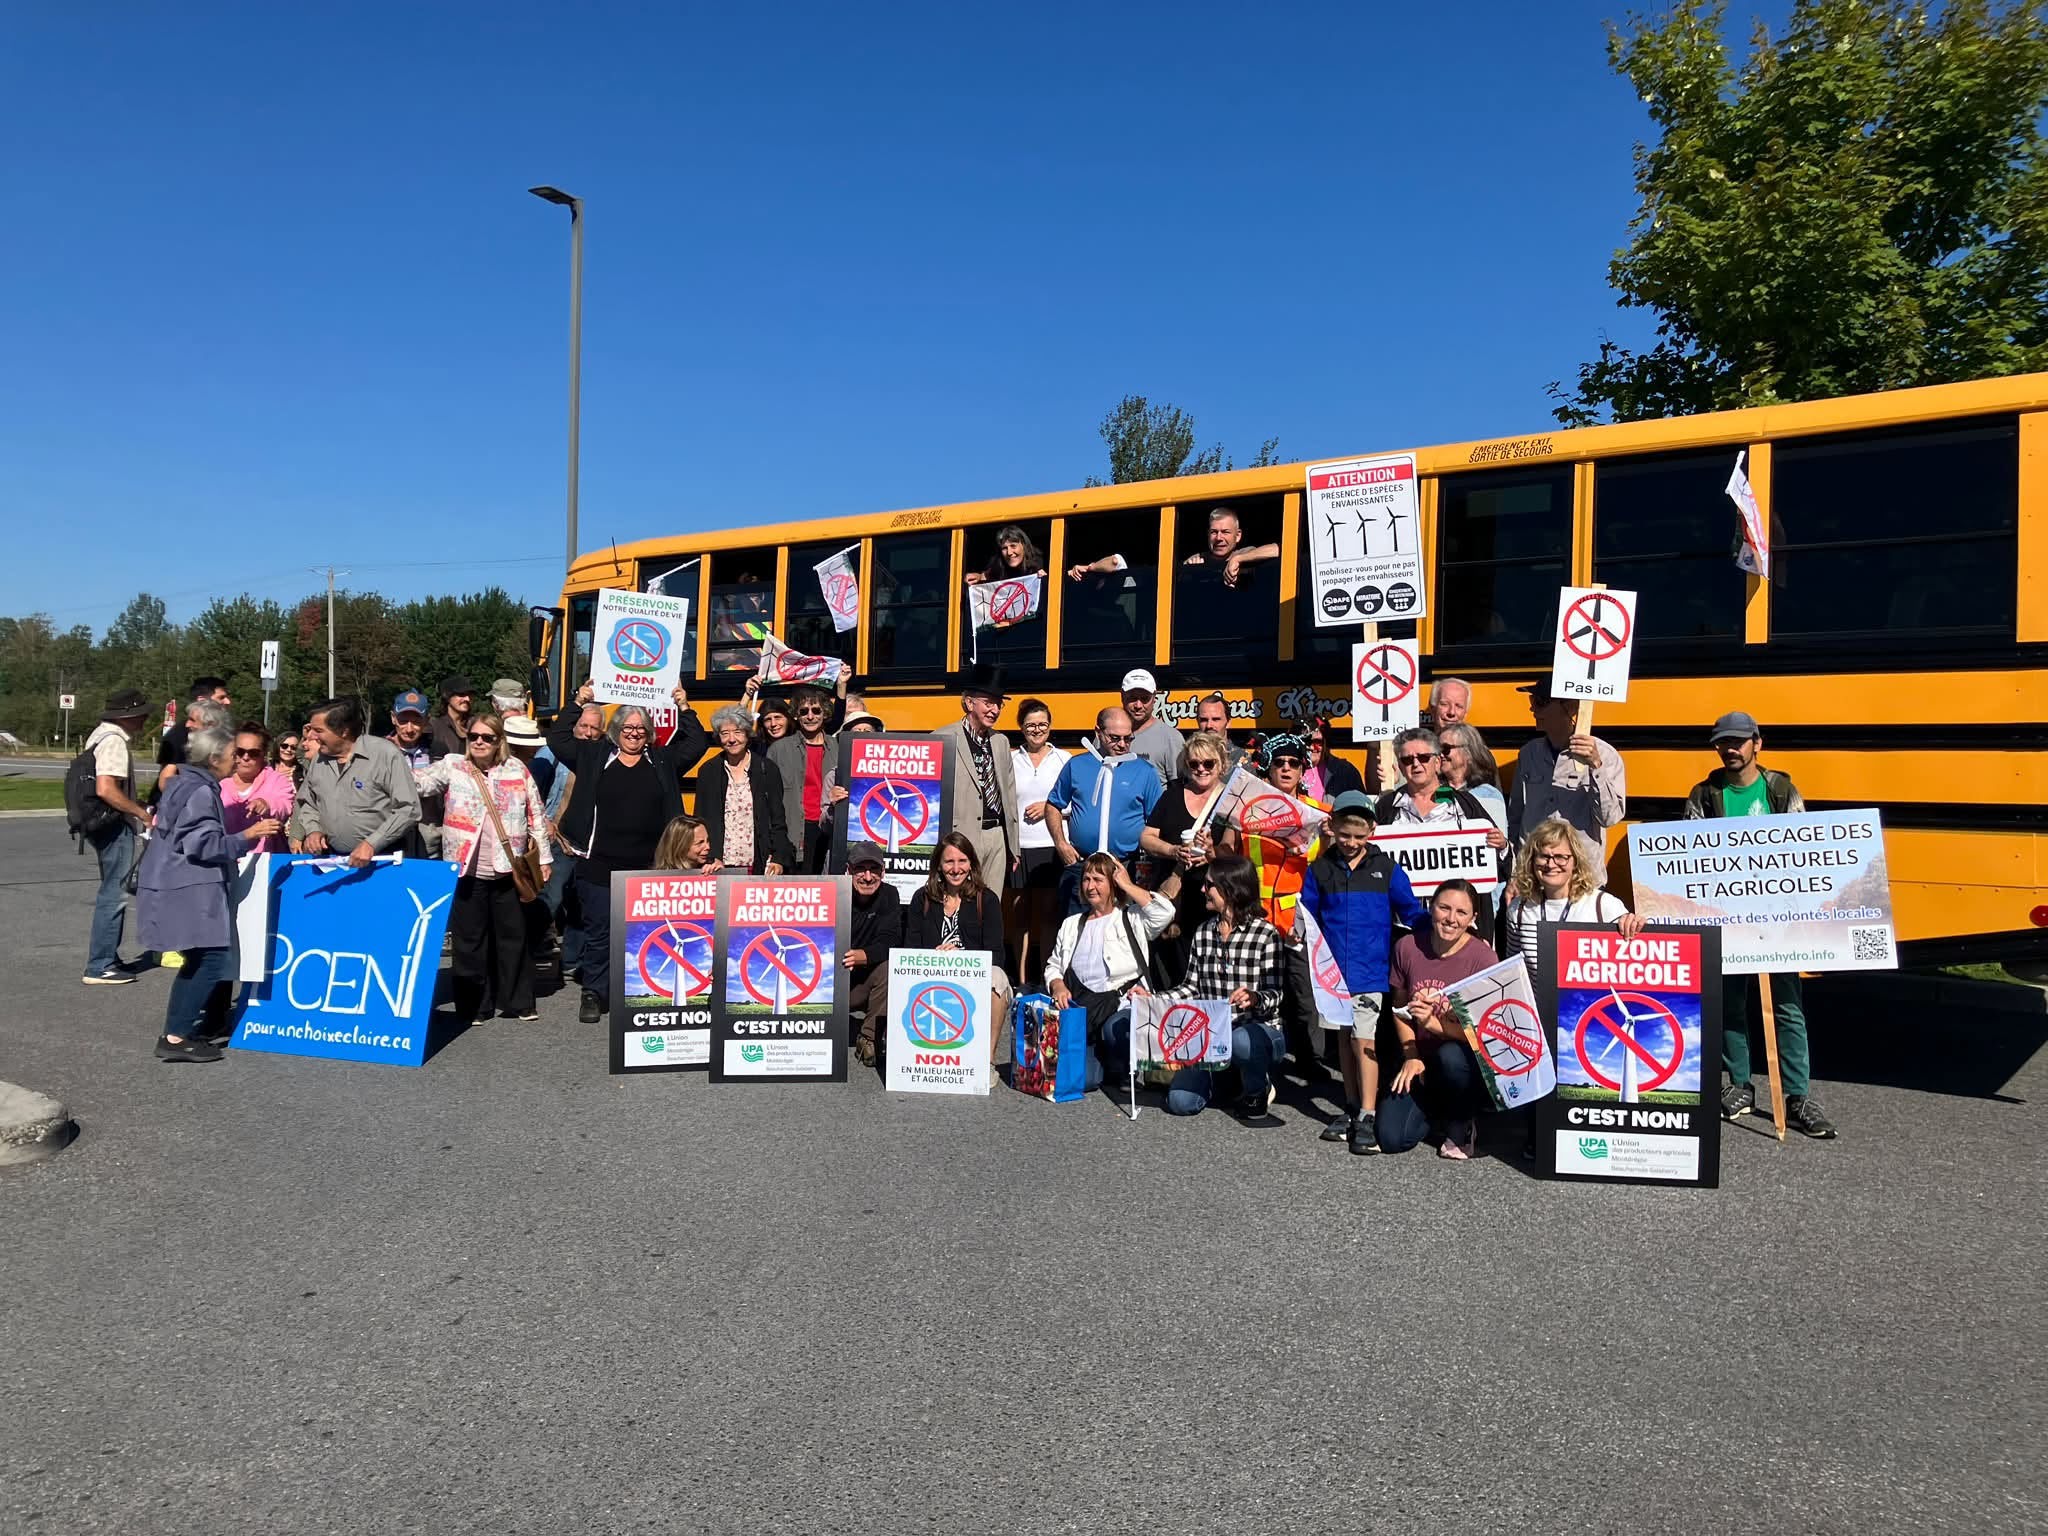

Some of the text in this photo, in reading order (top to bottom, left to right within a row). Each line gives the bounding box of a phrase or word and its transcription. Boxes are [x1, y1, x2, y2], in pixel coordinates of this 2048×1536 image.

[1469, 444, 1553, 463] SORTIE DE SECOURS
[1473, 437, 1552, 454] EMERGENCY EXIT
[1328, 468, 1396, 487] ATTENTION
[1320, 488, 1360, 500] PRÉSENCE
[1331, 494, 1394, 508] ENVAHISSANTES
[1319, 565, 1373, 577] mobilisez-vous
[1374, 563, 1390, 573] pour
[1402, 561, 1416, 570] pas
[1322, 570, 1414, 587] propager les envahisseurs
[608, 594, 680, 611] PRÉSERVONS
[602, 604, 683, 620] NOTRE QUALITÉ DE VIE
[615, 673, 655, 686] NON
[1564, 681, 1614, 695] Pas ici
[614, 683, 638, 692] MILIEU
[640, 686, 665, 695] HABITÉ
[620, 690, 656, 700] AGRICOLE
[1152, 687, 1353, 727] Autus Kiro
[1363, 726, 1388, 736] Pas
[865, 743, 930, 760] EN ZONE
[856, 758, 936, 776] AGRICOLE
[1638, 823, 1873, 853] NON AU SACCAGE DES
[893, 858, 931, 871] NON!
[1656, 849, 1859, 876] MILIEUX NATURELS
[641, 880, 716, 898] EN ZONE
[745, 887, 821, 904] EN ZONE
[1686, 876, 1833, 899] ET AGRICOLES
[632, 899, 715, 917] AGRICOL
[735, 905, 829, 922] AGRICOLE
[1694, 914, 1742, 926] respect
[1745, 911, 1768, 924] des
[1771, 907, 1829, 922] volontés
[1833, 906, 1881, 920] locales
[1577, 938, 1680, 962] EN ZONE
[900, 954, 981, 968] PRÉSERVONS
[923, 968, 958, 977] QUALITÉ
[972, 970, 986, 978] VIE
[1565, 960, 1691, 986] AGRICOLE
[632, 1012, 678, 1027] C'EST
[733, 1020, 826, 1035] C'EST NON!
[641, 1036, 664, 1045] UPA
[1169, 1015, 1204, 1054] MORATOIRE
[1486, 1022, 1539, 1052] MORATOIRE
[741, 1044, 763, 1053] UPA
[915, 1053, 960, 1066] NON
[914, 1066, 942, 1075] MILIEU
[944, 1067, 974, 1076] HABITÉ
[923, 1075, 964, 1084] AGRICOLE
[1567, 1106, 1690, 1130] C'EST NON!
[1579, 1137, 1607, 1148] UPA
